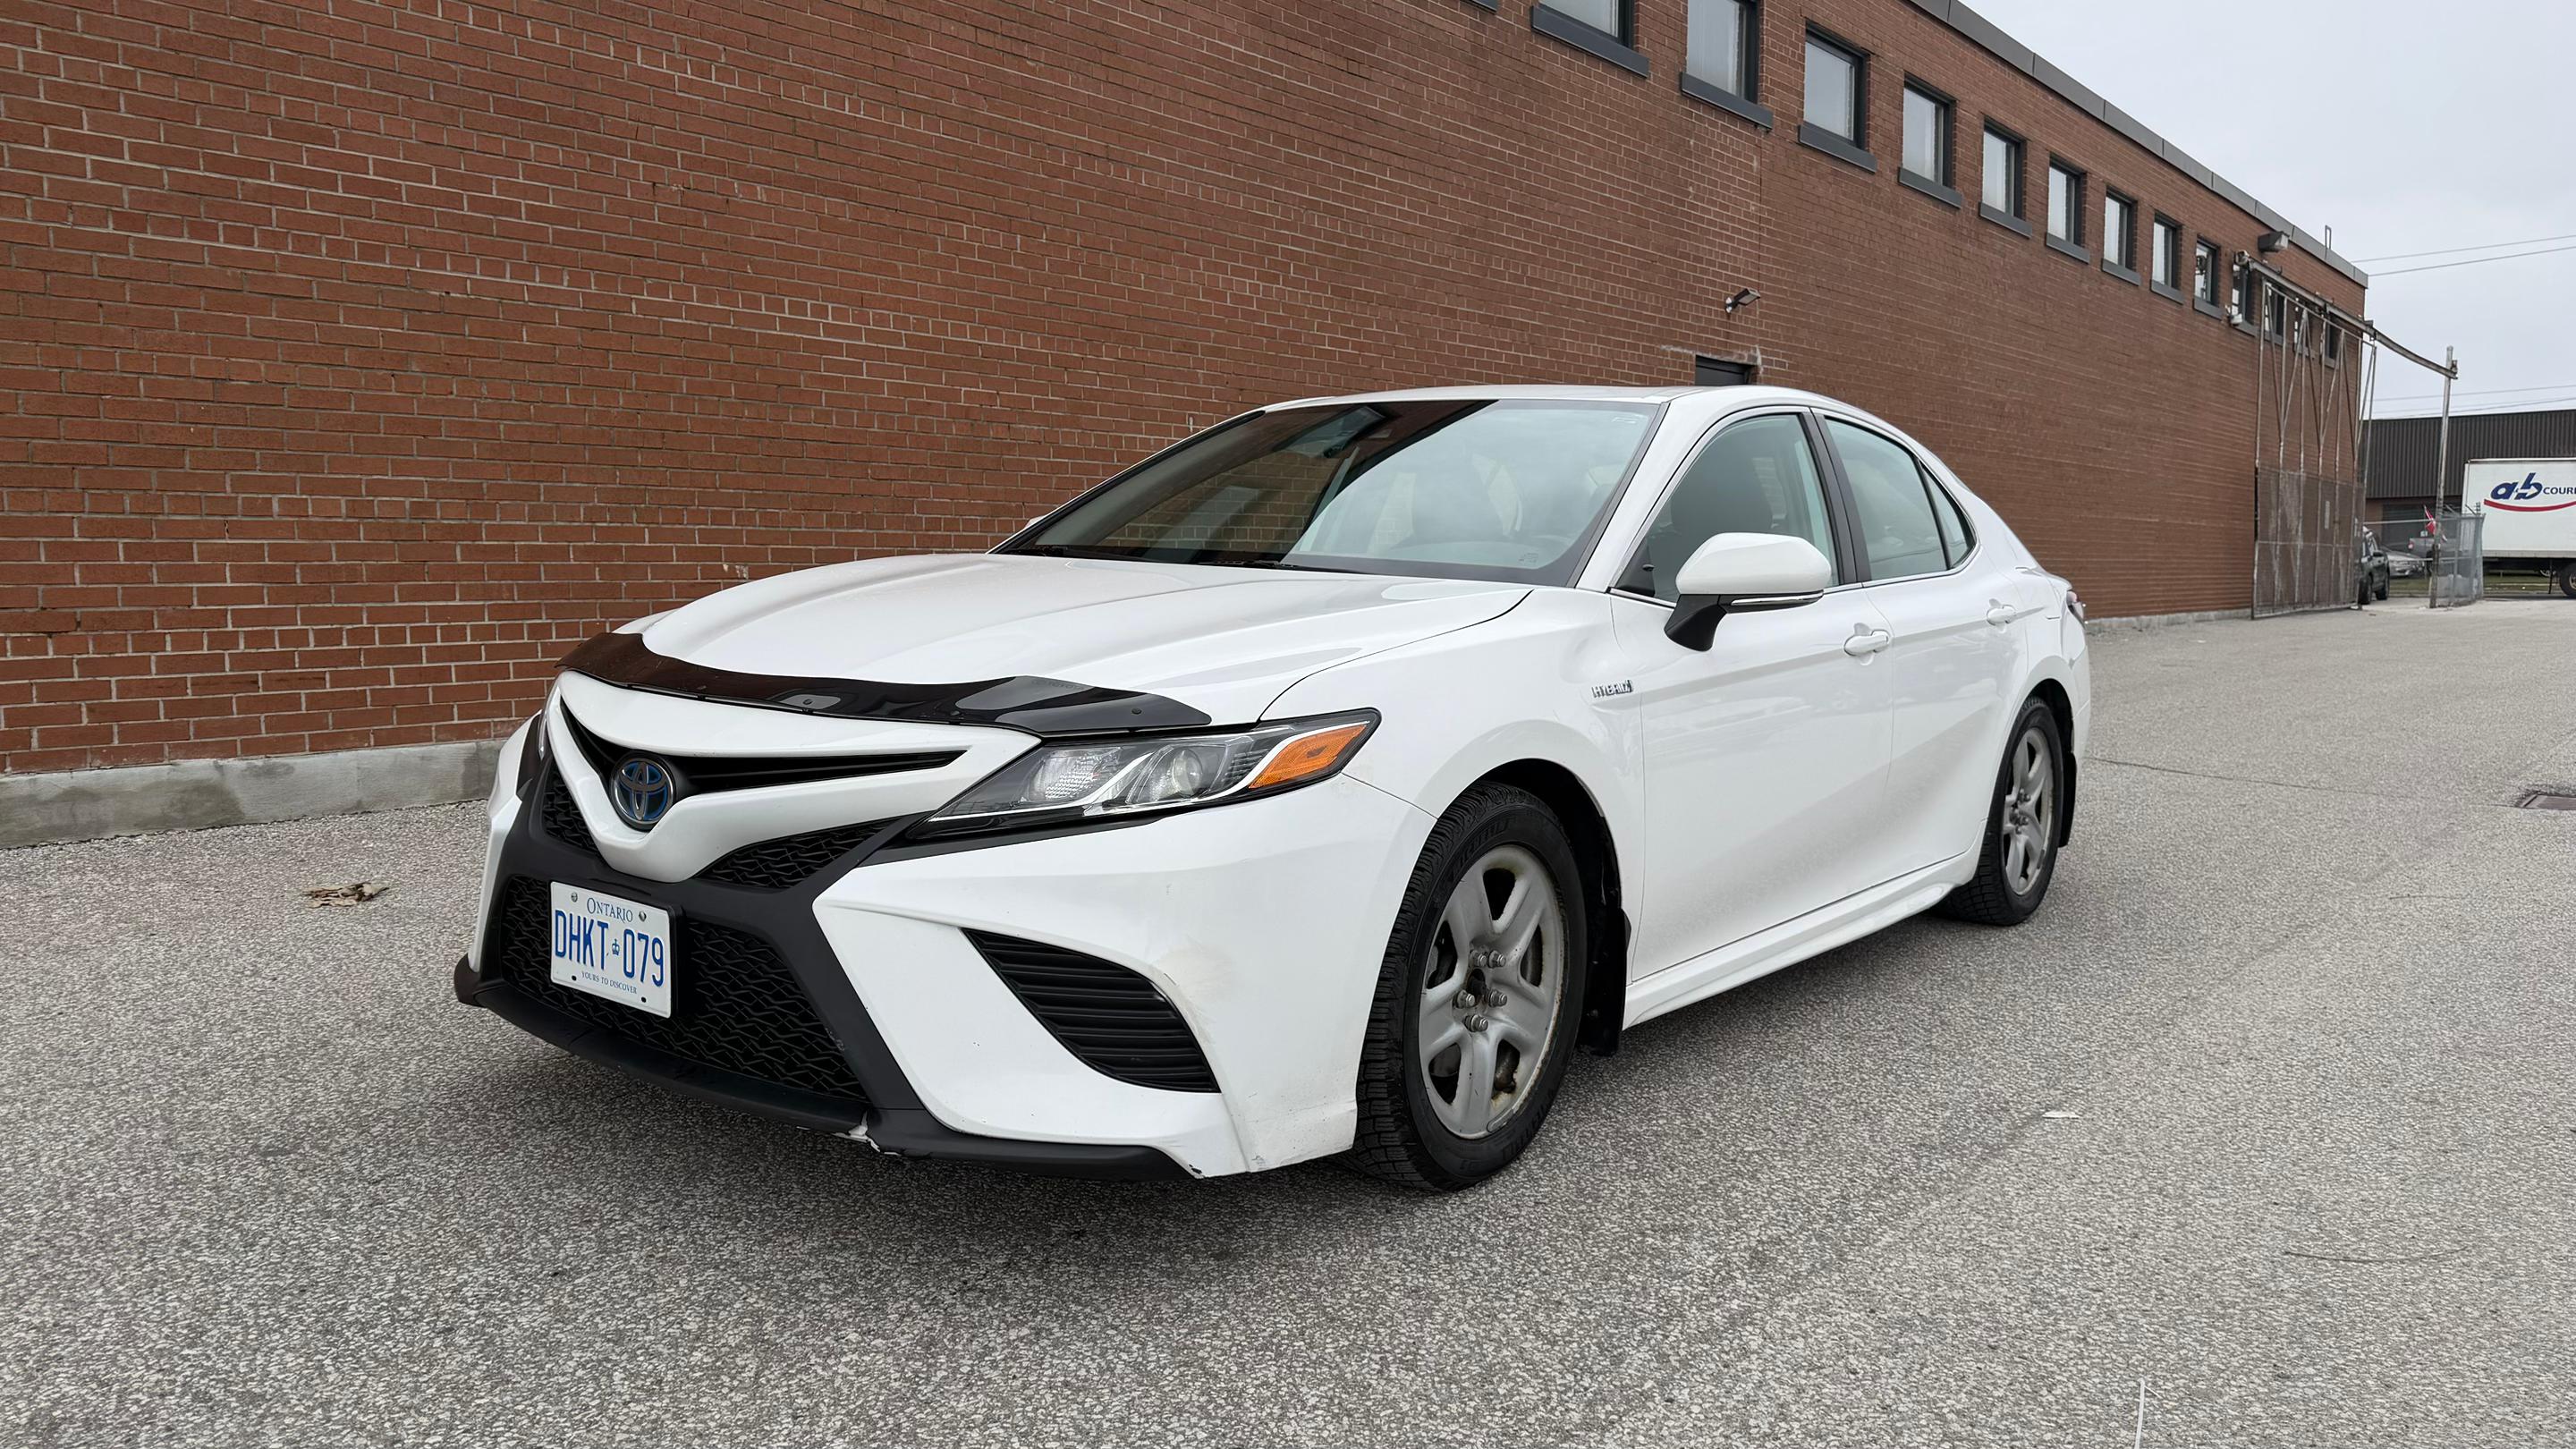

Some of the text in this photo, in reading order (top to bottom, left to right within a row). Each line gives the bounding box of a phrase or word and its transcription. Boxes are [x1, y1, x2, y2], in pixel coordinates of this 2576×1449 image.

[1591, 680, 1632, 698] HYBRID
[587, 897, 633, 923] ONTARIO
[581, 971, 599, 982] YOURS
[609, 980, 637, 994] DISCOVER
